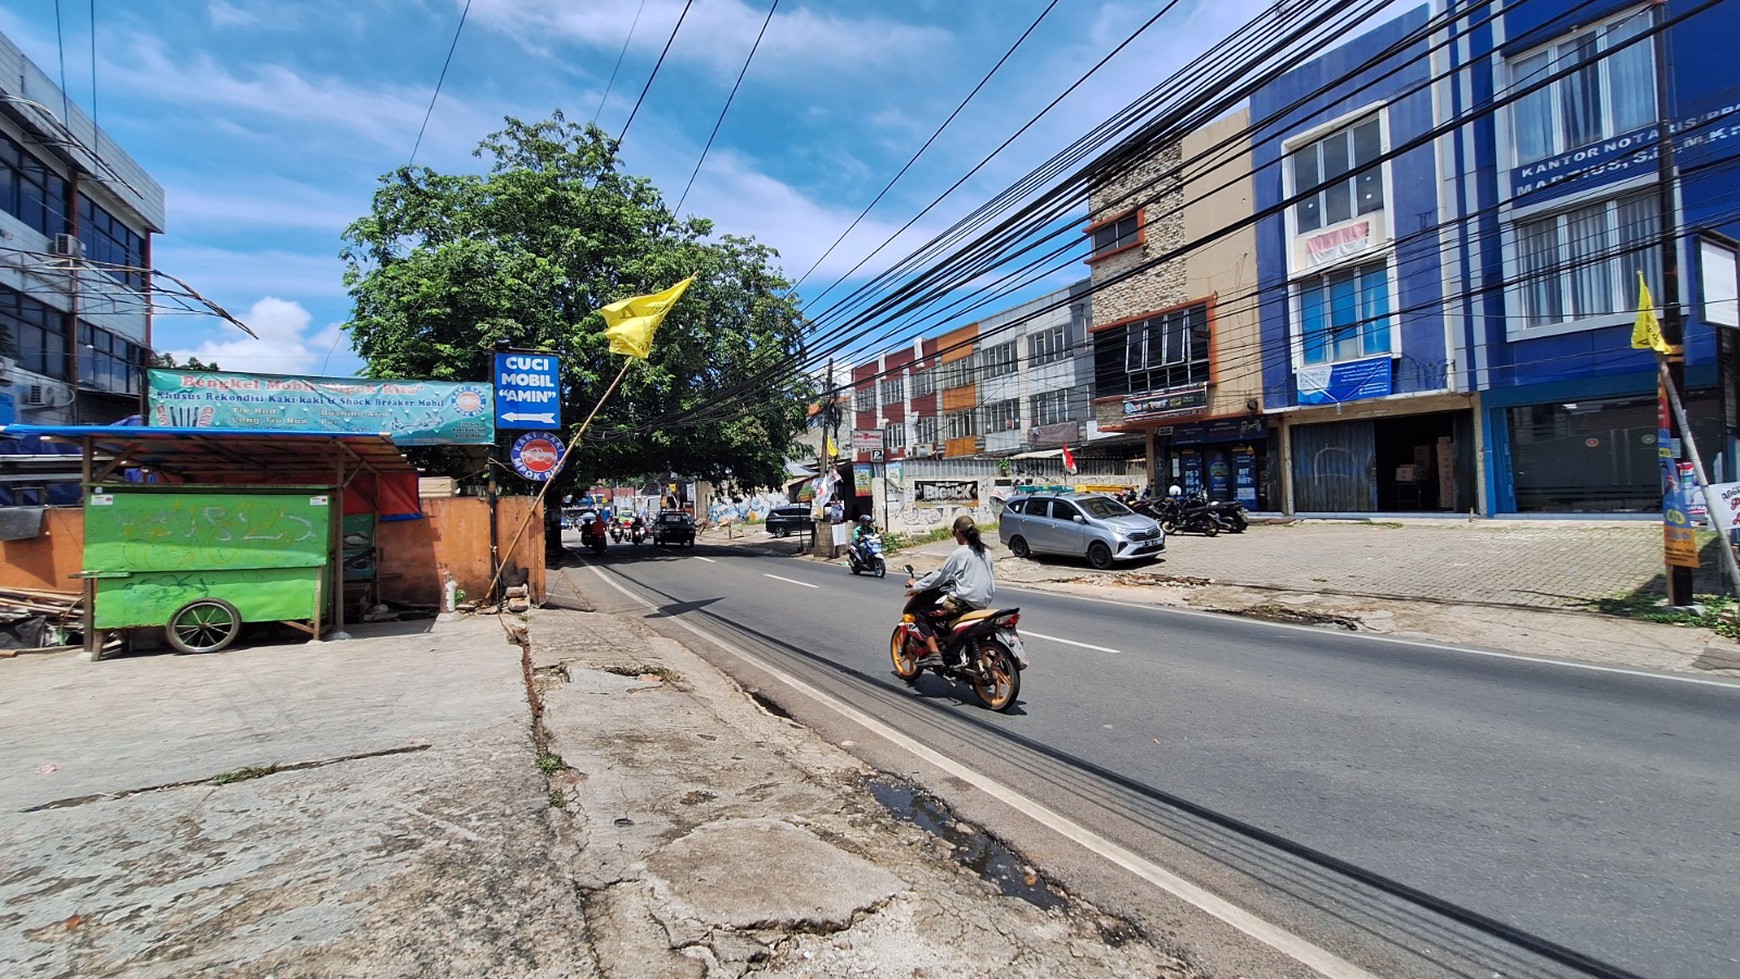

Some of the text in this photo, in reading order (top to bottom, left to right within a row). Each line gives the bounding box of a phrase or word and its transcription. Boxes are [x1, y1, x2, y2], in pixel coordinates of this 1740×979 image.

[1521, 147, 1598, 178] KANTOR
[506, 357, 549, 370] CUCI
[182, 375, 259, 392] Bengkel
[501, 373, 555, 387] MOBIL
[157, 391, 201, 401] Khusus
[206, 392, 264, 402] Rekondisi
[340, 397, 372, 406] Shock
[375, 397, 415, 407] Breaker
[418, 399, 445, 408] Mobil
[499, 389, 557, 403] "AMIN"
[231, 407, 277, 415] Tie Rod
[231, 416, 261, 425] Long
[286, 417, 309, 425] Rod
[514, 431, 566, 452] KAKI KAKI
[514, 457, 542, 480] MPOK
